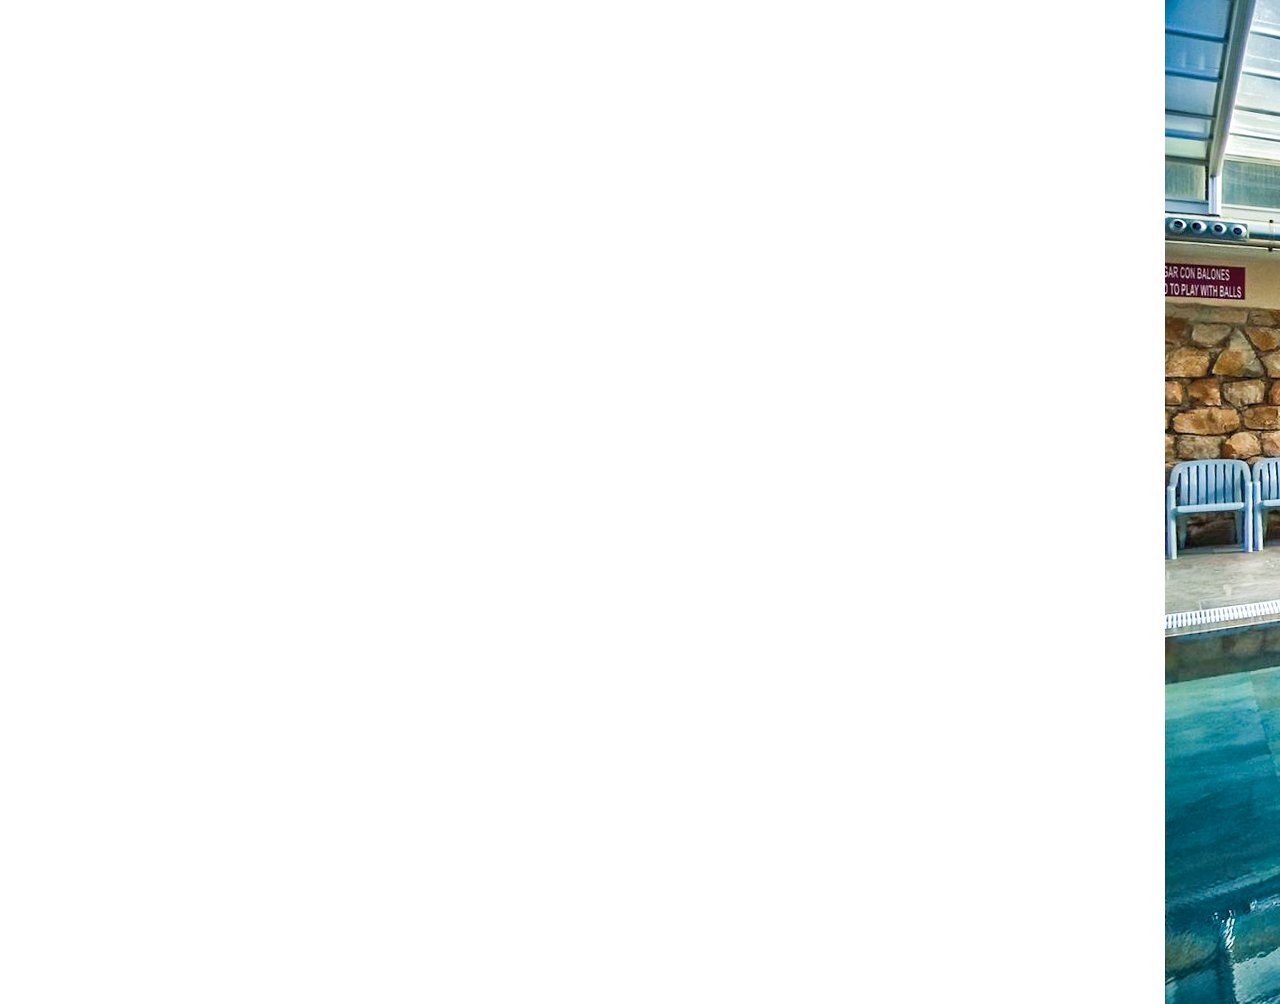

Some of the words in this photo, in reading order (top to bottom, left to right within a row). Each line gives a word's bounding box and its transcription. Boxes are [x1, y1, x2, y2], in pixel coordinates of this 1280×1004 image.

[1180, 267, 1195, 279] CON
[1197, 268, 1230, 281] BALONES
[1170, 283, 1180, 295] TO
[1181, 284, 1199, 296] PLAY
[1200, 285, 1218, 297] WITH
[1220, 286, 1242, 298] BALLS
